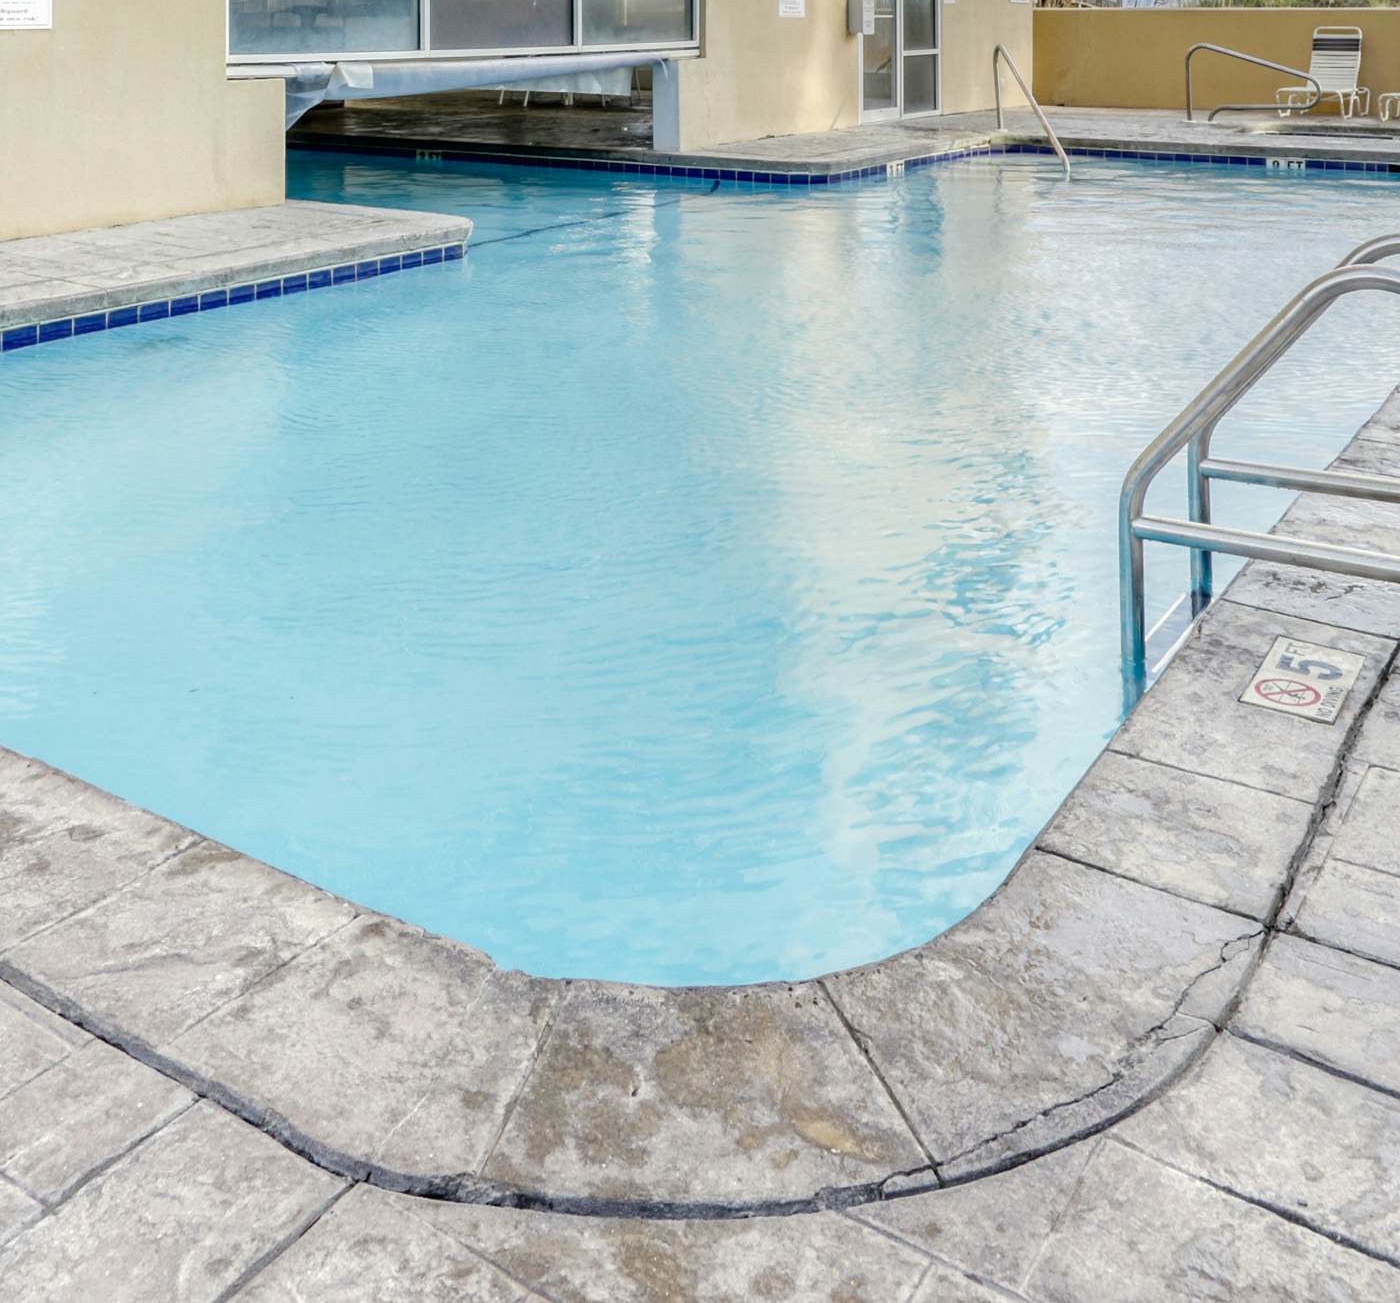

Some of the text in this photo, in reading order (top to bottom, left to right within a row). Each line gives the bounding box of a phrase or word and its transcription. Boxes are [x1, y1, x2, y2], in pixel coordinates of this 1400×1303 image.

[1275, 641, 1344, 681] 5 FT
[1320, 686, 1344, 708] DIVING
